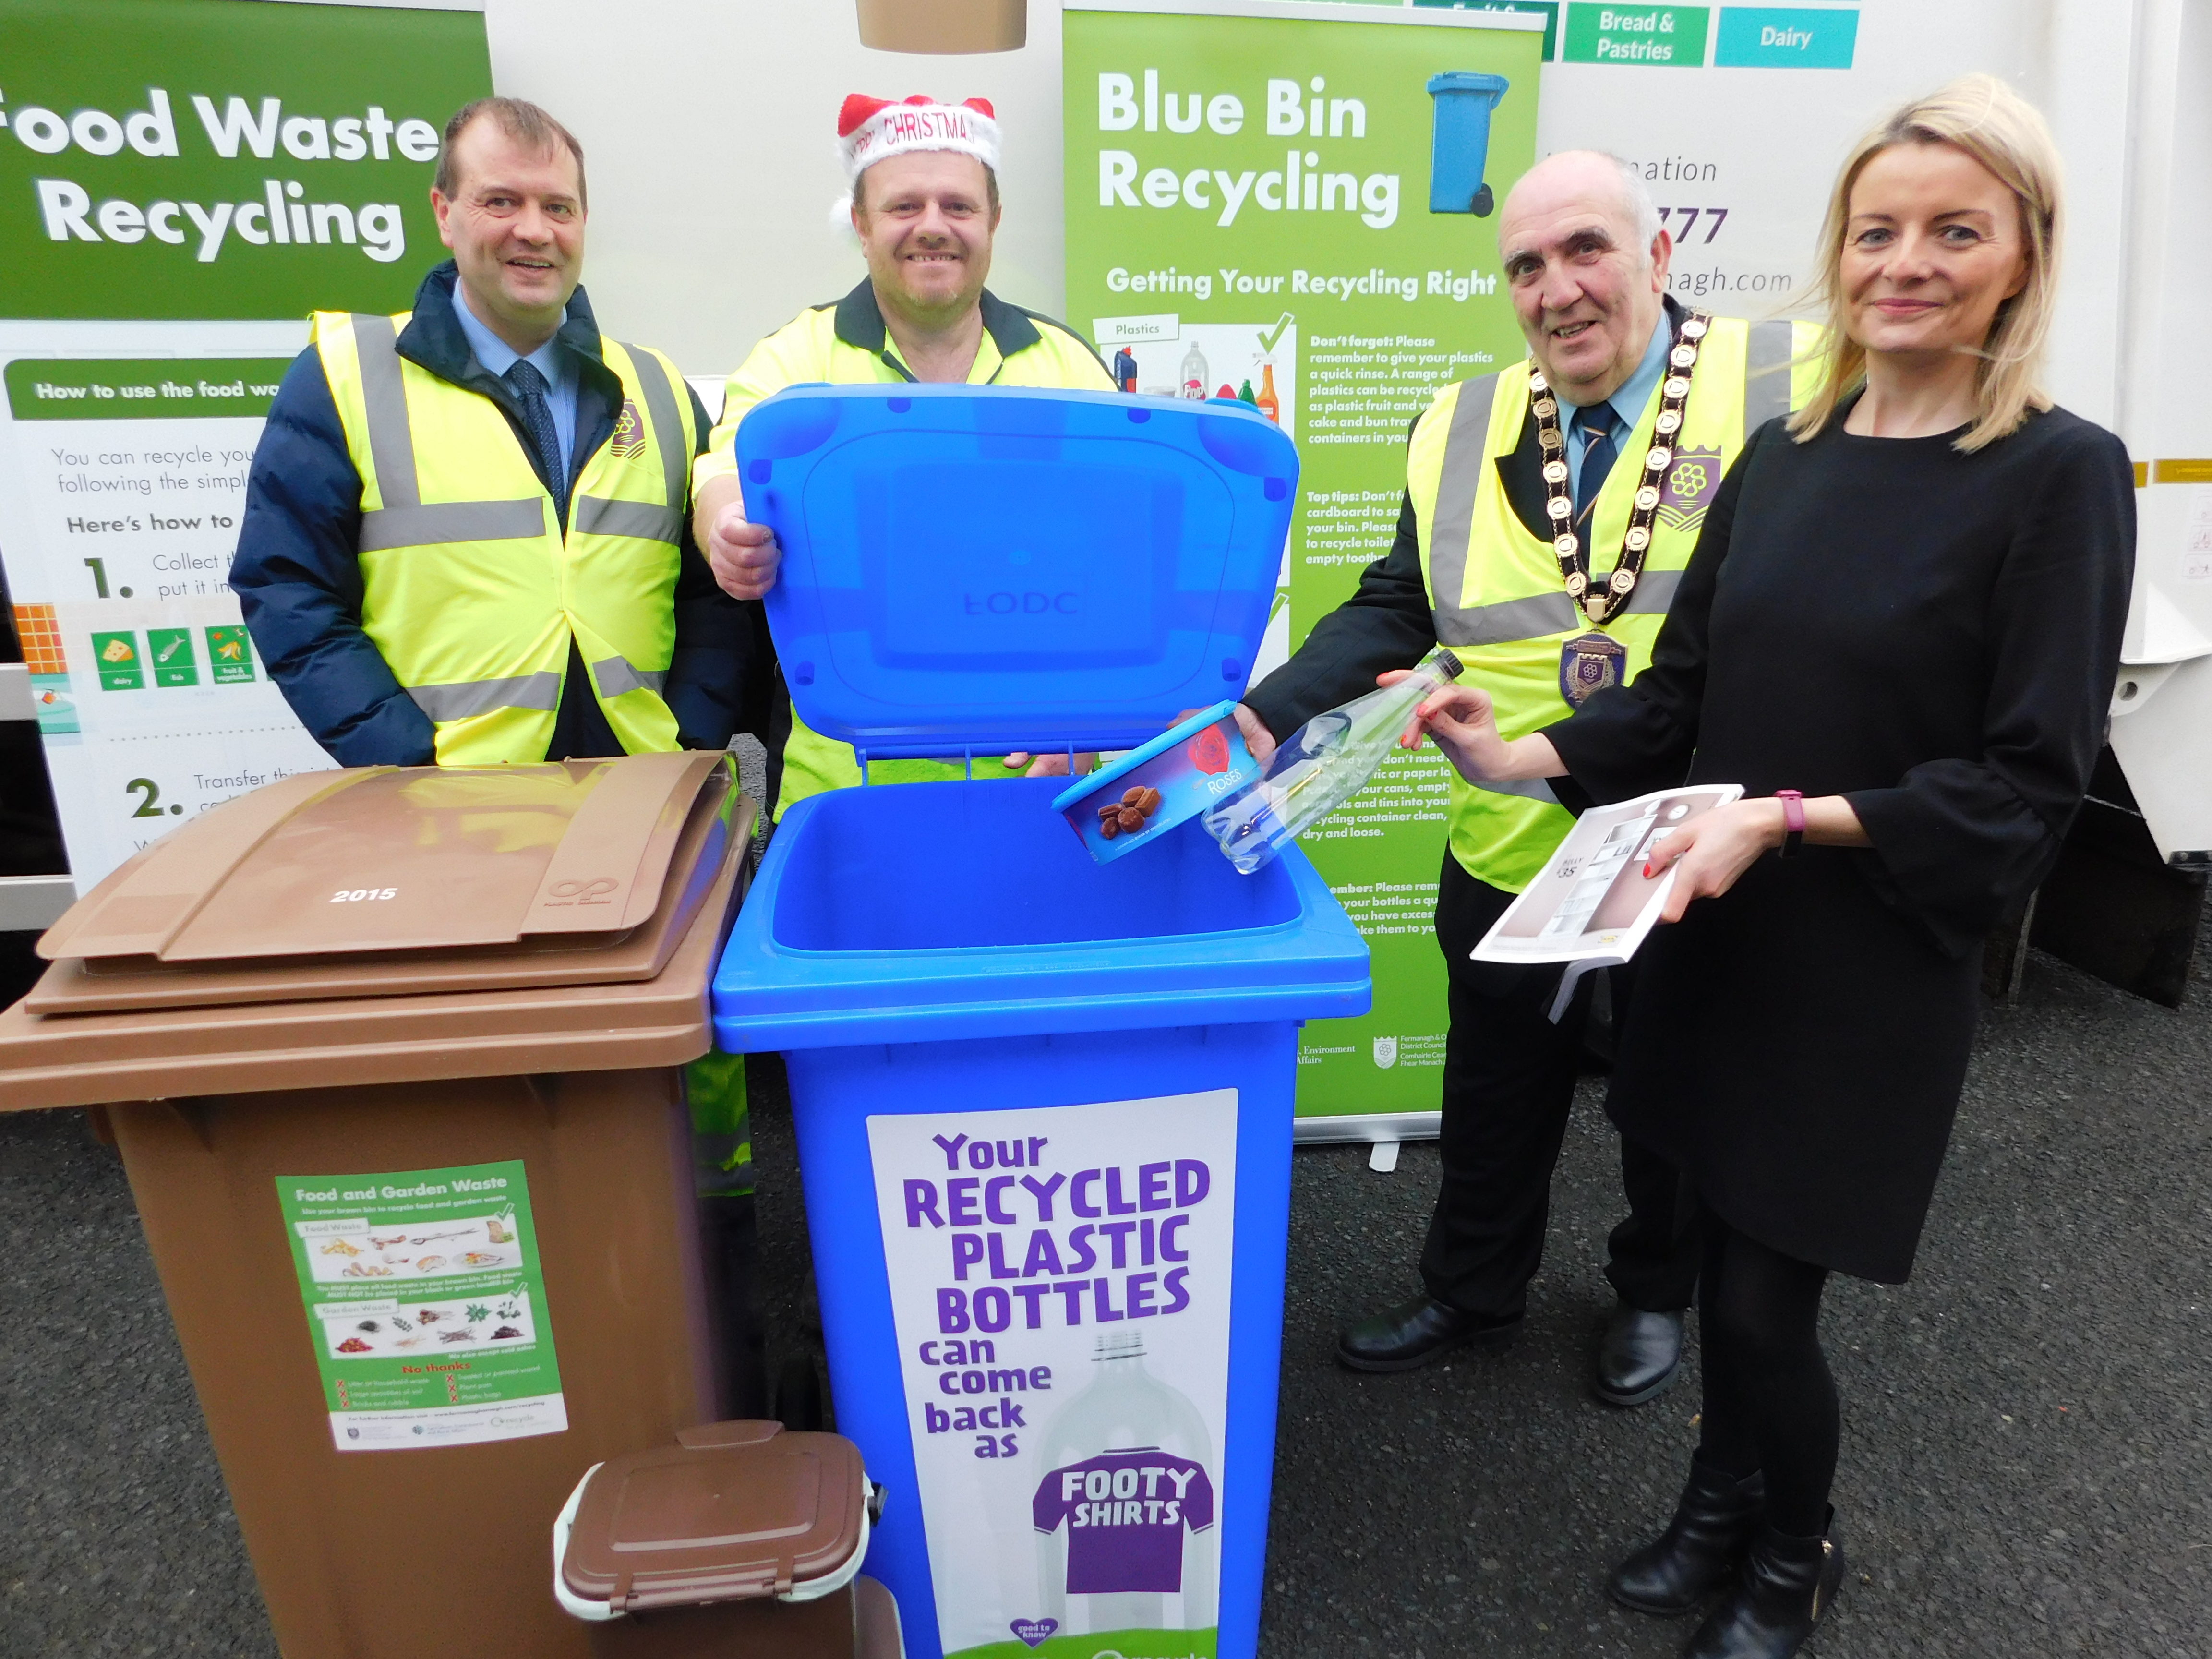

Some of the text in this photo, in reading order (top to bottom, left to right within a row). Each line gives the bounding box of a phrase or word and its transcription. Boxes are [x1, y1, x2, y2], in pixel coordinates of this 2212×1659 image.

[1599, 12, 1674, 33] Bread &
[1760, 26, 1813, 50] Dairy
[1597, 38, 1672, 60] Pastries
[1098, 69, 1366, 138] Blue Bin
[0, 87, 439, 161] ood Waste
[1099, 150, 1400, 229] Recycling
[37, 179, 406, 262] Recycling
[1106, 267, 1497, 301] Getting Your Recycling Right
[1116, 325, 1160, 335] Plastics
[1349, 335, 1393, 349] forget:
[1396, 336, 1435, 347] Please
[1310, 351, 1493, 366] remember to give your plastics
[1310, 367, 1454, 383] a quick rinse. A range of
[36, 383, 86, 399] How
[94, 384, 115, 398] to
[120, 385, 156, 398] use
[161, 381, 193, 398] the
[198, 380, 245, 397] food
[1310, 384, 1354, 397] plastics
[1357, 386, 1377, 395] can
[1380, 384, 1395, 395] be
[1309, 402, 1322, 411] as
[1325, 400, 1364, 414] plastic
[1366, 400, 1391, 411] fruit
[1394, 400, 1416, 410] and
[1309, 415, 1388, 428] cake and bun
[1309, 431, 1408, 445] containers in you
[51, 445, 254, 470] You can recycle you
[58, 469, 246, 496] following the simpl
[1307, 492, 1329, 505] Top
[1332, 491, 1359, 505] tips:
[1307, 506, 1384, 517] cardboard to
[150, 513, 202, 530] how
[211, 514, 233, 529] to
[1306, 523, 1334, 535] your
[1337, 522, 1359, 533] bin.
[1306, 540, 1318, 549] to
[1321, 537, 1362, 551] recycle
[152, 553, 219, 571] Collect
[1305, 554, 1343, 566] empty
[84, 557, 134, 599] 1.
[158, 582, 187, 601] put
[195, 580, 206, 595] it
[1415, 753, 1444, 762] need
[194, 769, 266, 789] Transfer
[1207, 769, 1242, 795] ROSES
[1389, 770, 1401, 778] or
[1403, 769, 1438, 780] paper
[125, 777, 184, 818] 2.
[1384, 784, 1413, 793] cans,
[1354, 797, 1376, 808] and
[1378, 797, 1399, 807] tins
[1401, 797, 1423, 806] into
[1357, 812, 1411, 822] container
[1413, 810, 1447, 821] clean,
[1303, 827, 1384, 841] dry and loose.
[329, 887, 398, 902] 2015
[1330, 883, 1373, 894] ember:
[1375, 882, 1412, 892] Please
[1344, 900, 1370, 910] your
[1372, 895, 1411, 906] bottles
[1371, 910, 1399, 920] have
[1377, 924, 1419, 934] them to
[1304, 1045, 1356, 1055] Environment
[932, 1132, 1048, 1170] Your
[295, 1177, 507, 1202] Food and Garden Waste
[902, 1158, 1211, 1230] RECYCLED
[951, 1214, 1190, 1281] PLASTIC
[936, 1266, 1190, 1334] BOTTLES
[919, 1338, 995, 1366] can
[401, 1366, 422, 1374] No
[426, 1361, 471, 1372] thanks
[939, 1366, 1052, 1395] come
[925, 1397, 1027, 1434] back
[974, 1433, 1019, 1459] as
[1061, 1467, 1197, 1501] FOOTY
[1072, 1500, 1180, 1527] SHIRTS
